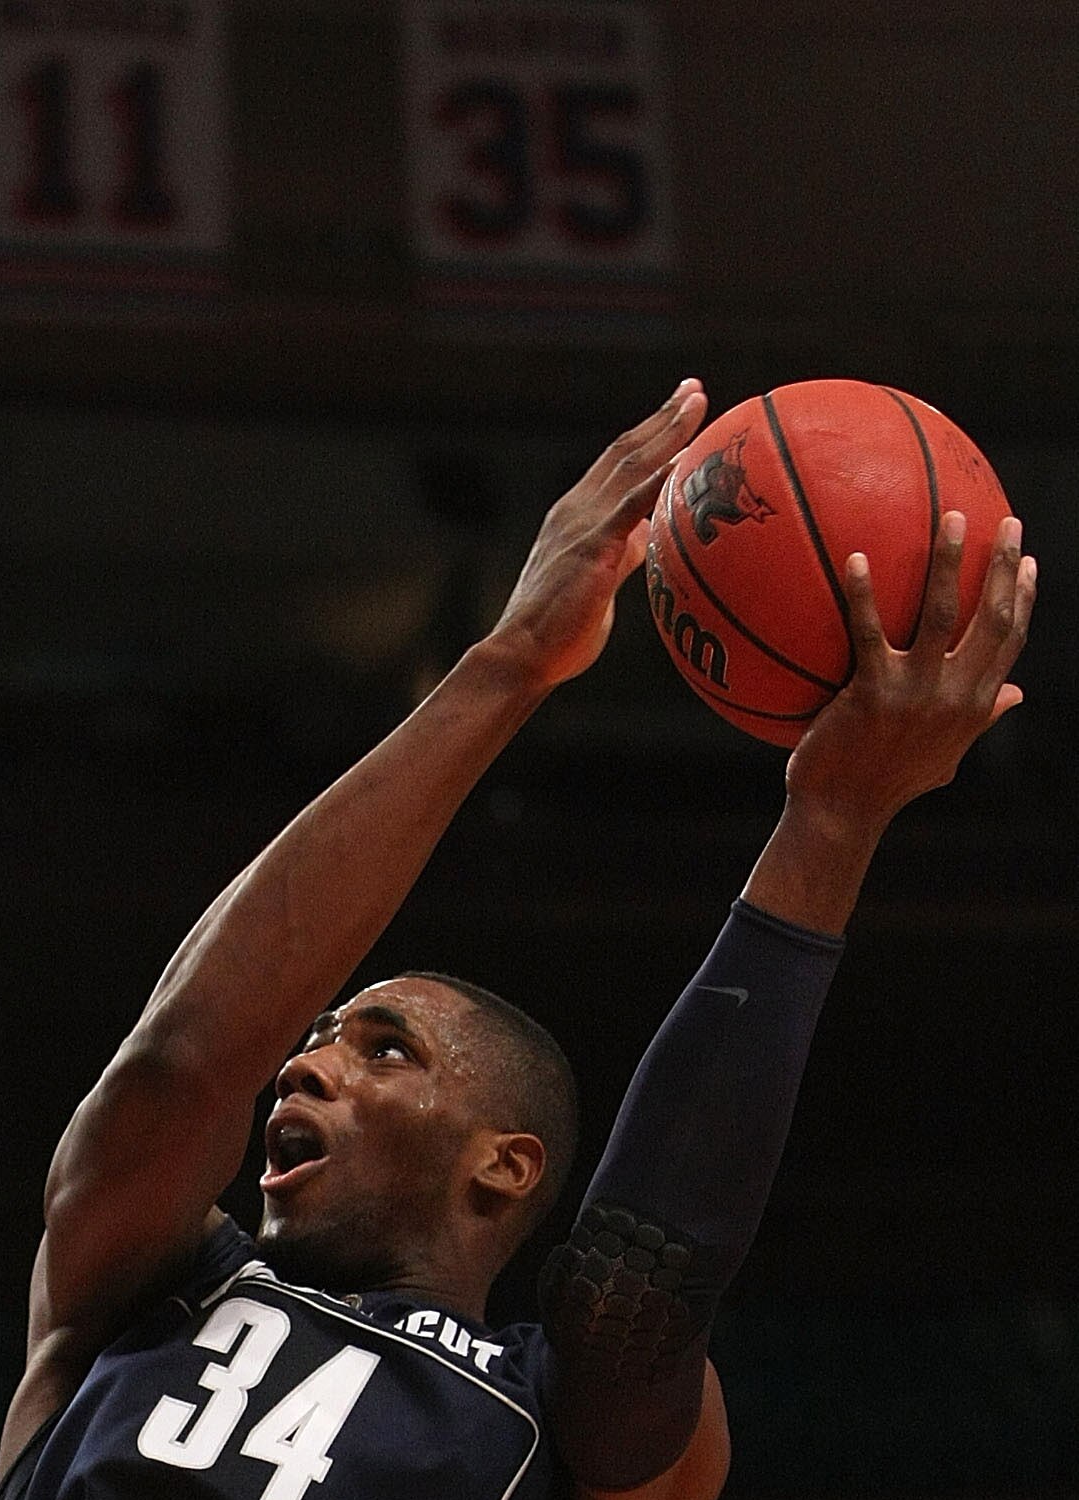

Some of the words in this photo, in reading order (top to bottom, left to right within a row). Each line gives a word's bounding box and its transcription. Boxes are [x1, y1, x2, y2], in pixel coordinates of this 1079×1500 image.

[15, 57, 174, 230] 11
[435, 74, 649, 248] 35
[394, 1309, 505, 1374] CUT
